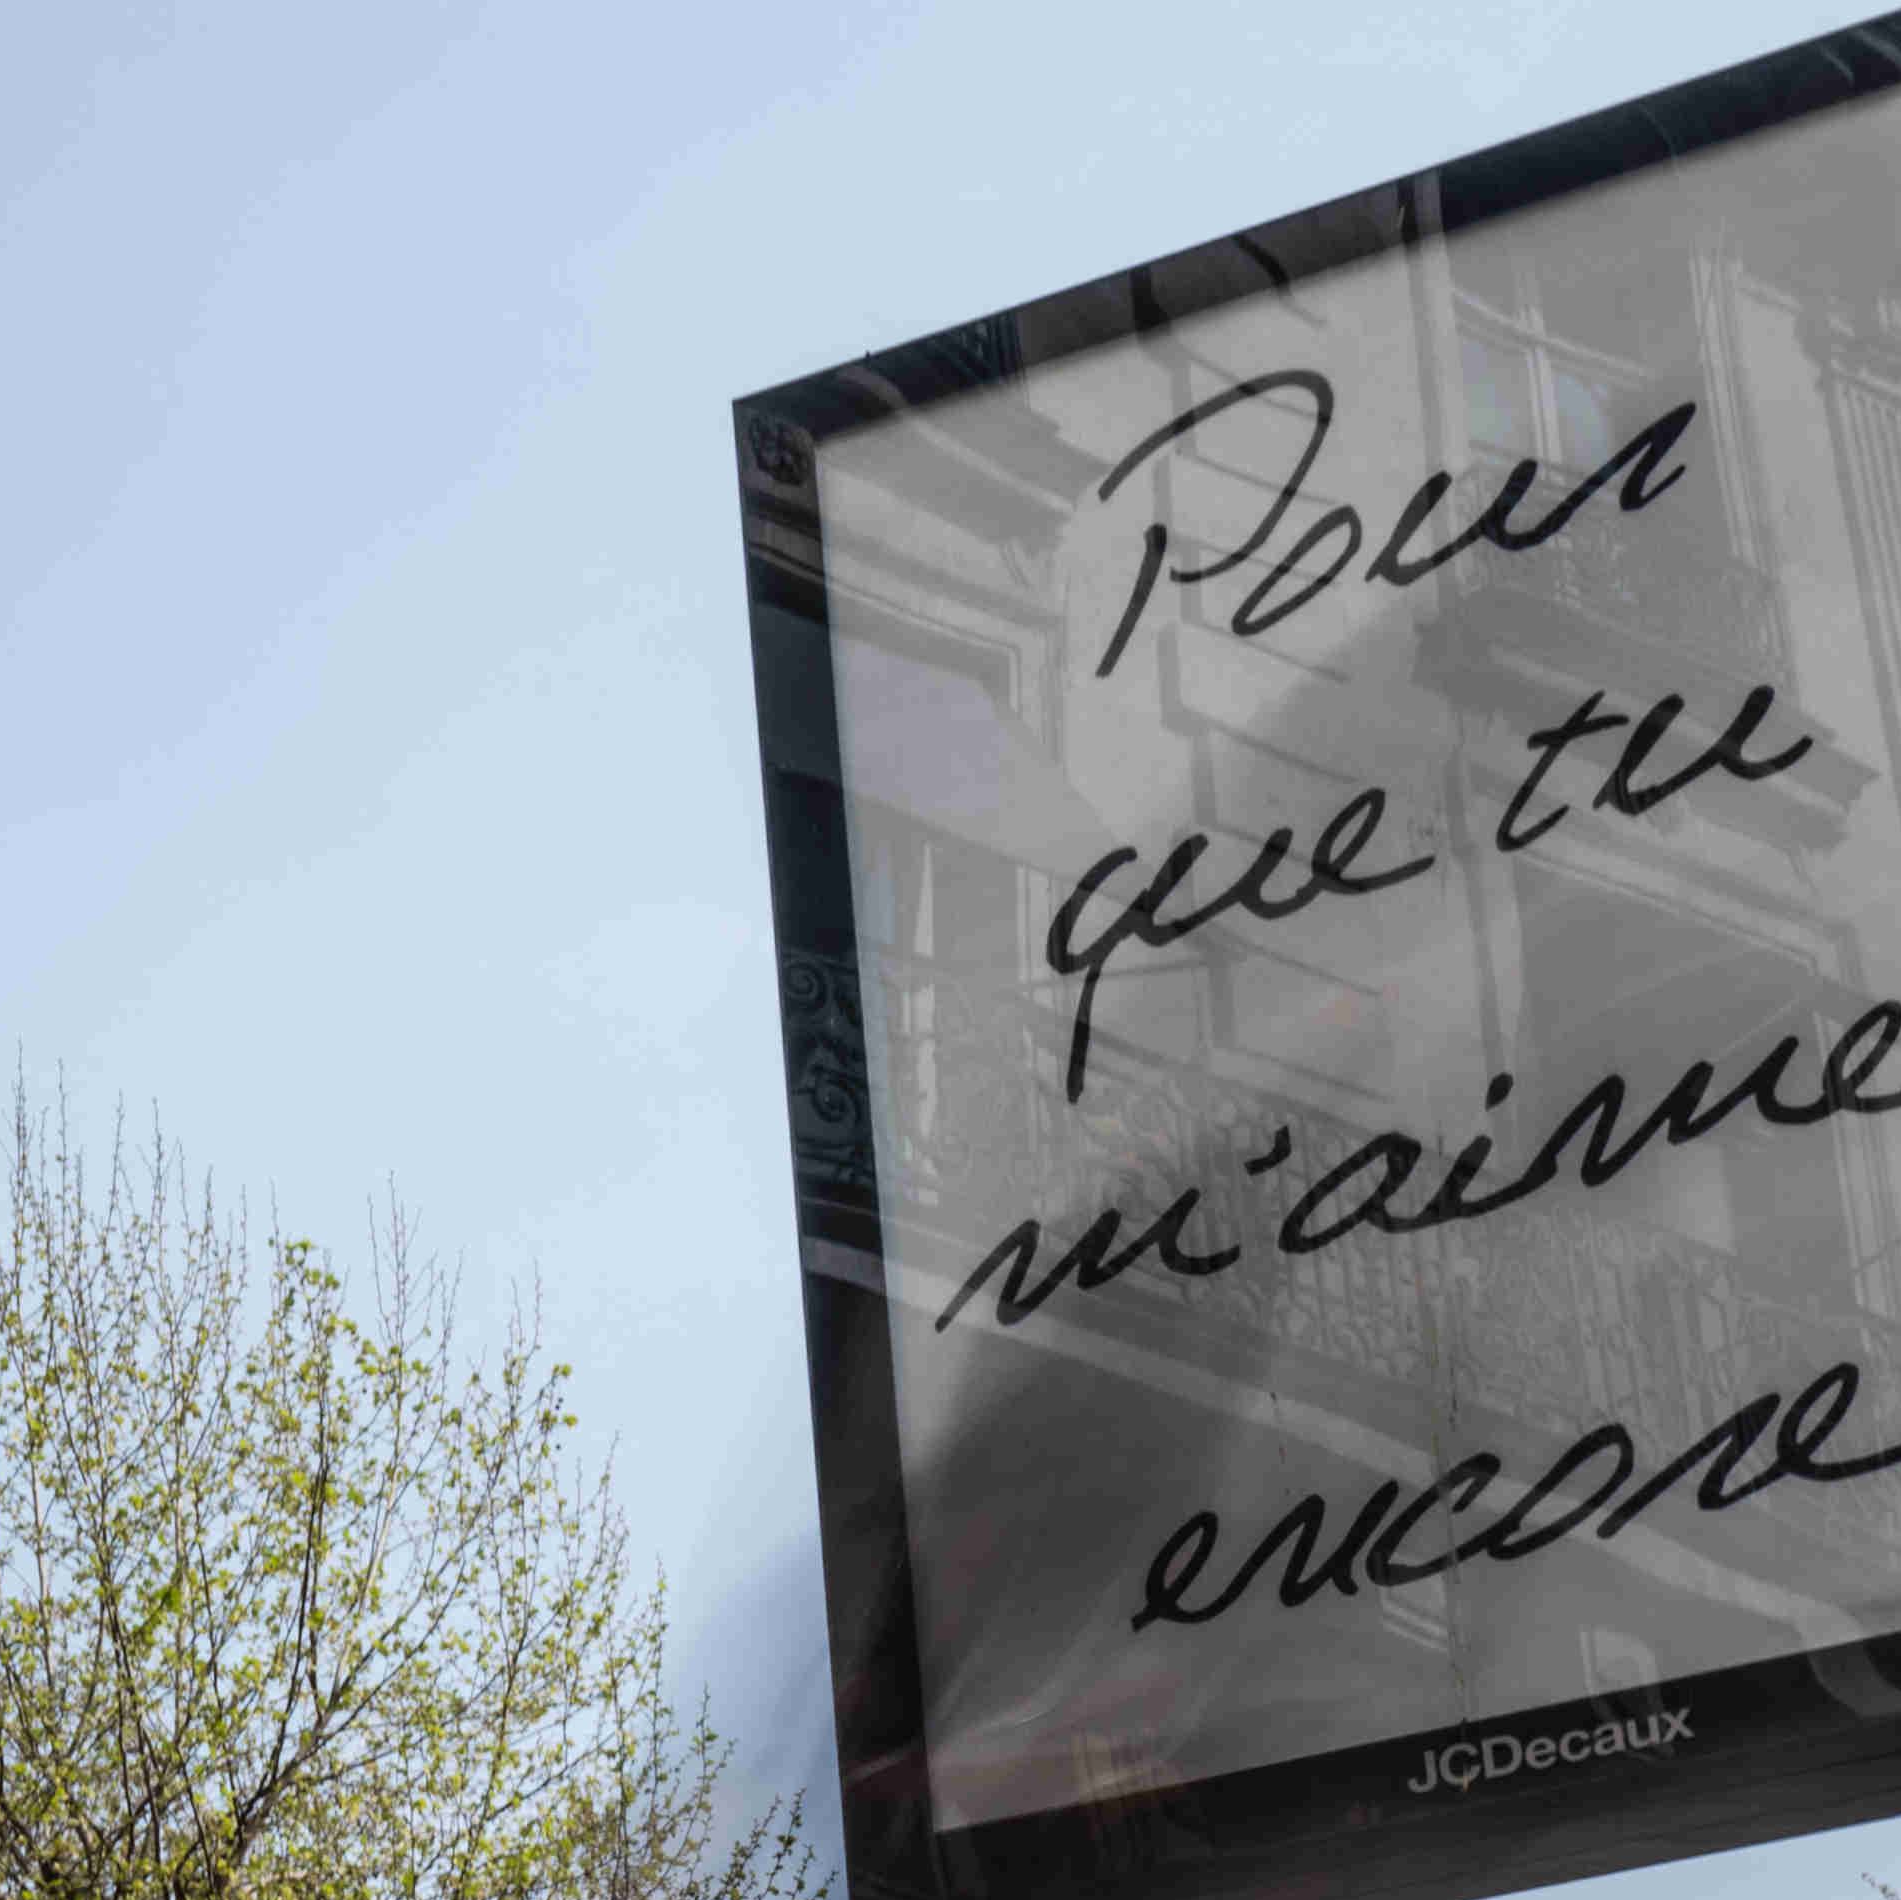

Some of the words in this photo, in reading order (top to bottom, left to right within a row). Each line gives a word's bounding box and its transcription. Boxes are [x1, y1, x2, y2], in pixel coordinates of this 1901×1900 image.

[1098, 369, 1696, 677] Pour
[1046, 788, 1435, 1103] que
[1495, 685, 1812, 851] tu
[1407, 1706, 1696, 1794] JCDecaux
